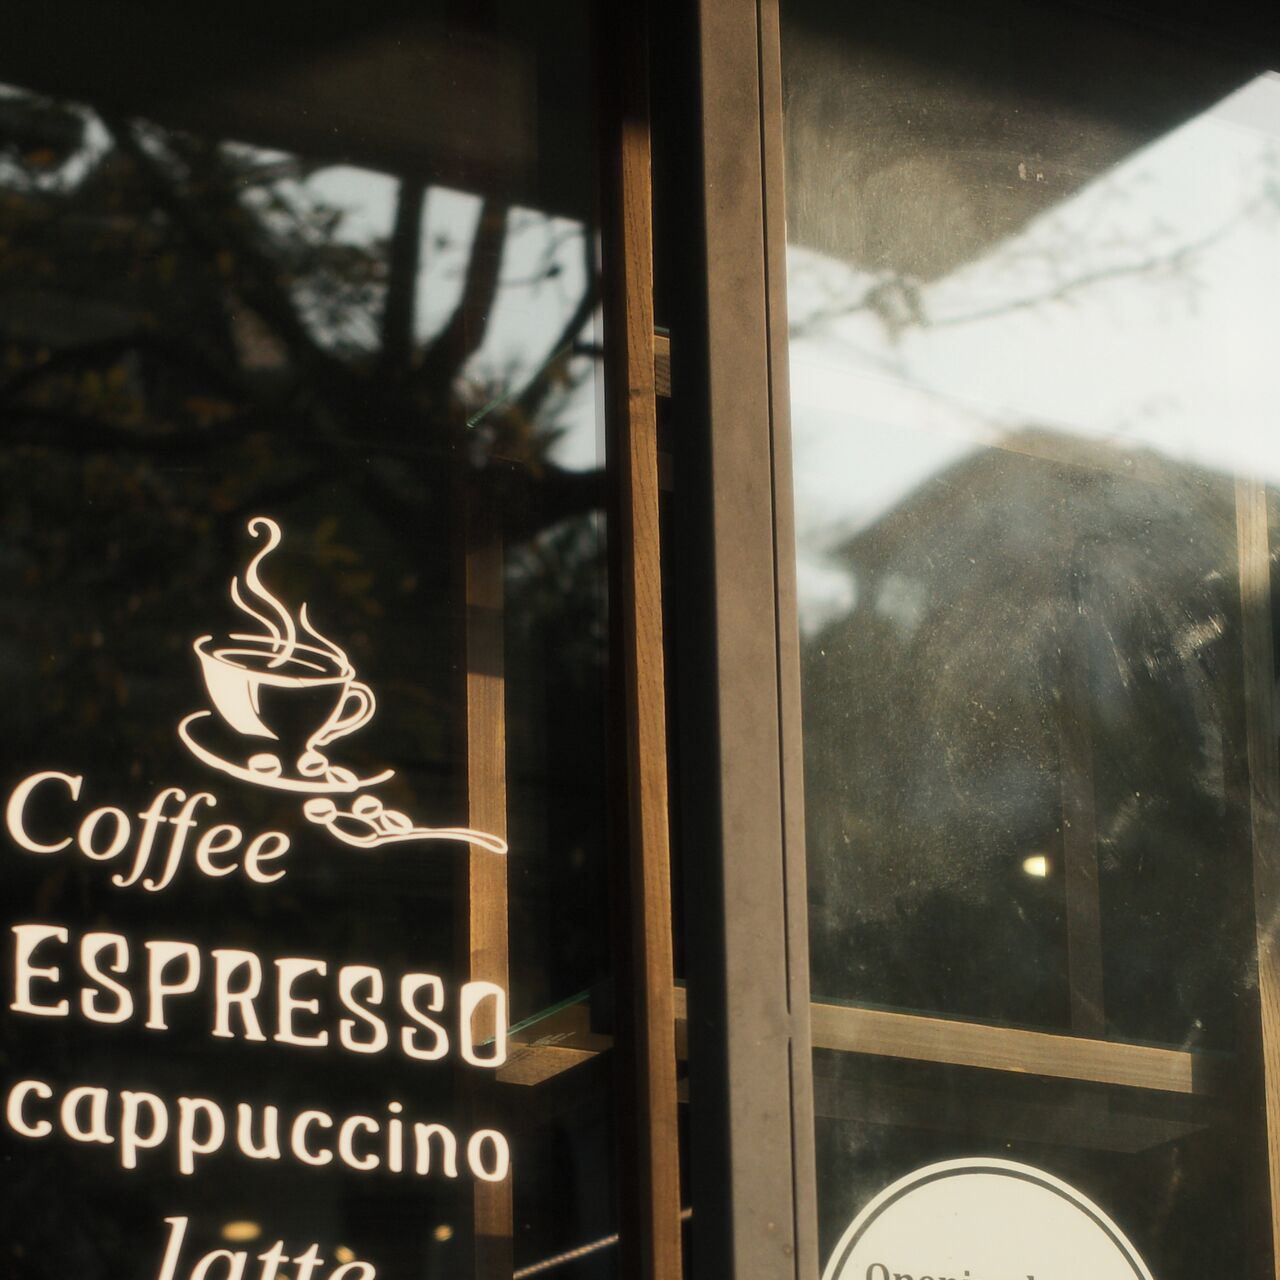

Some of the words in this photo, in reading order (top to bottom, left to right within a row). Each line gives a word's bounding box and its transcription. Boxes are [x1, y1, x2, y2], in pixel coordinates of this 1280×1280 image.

[6, 770, 291, 893] Coffee
[9, 924, 507, 1069] ESPRESSO
[6, 1080, 510, 1184] cappuccino
